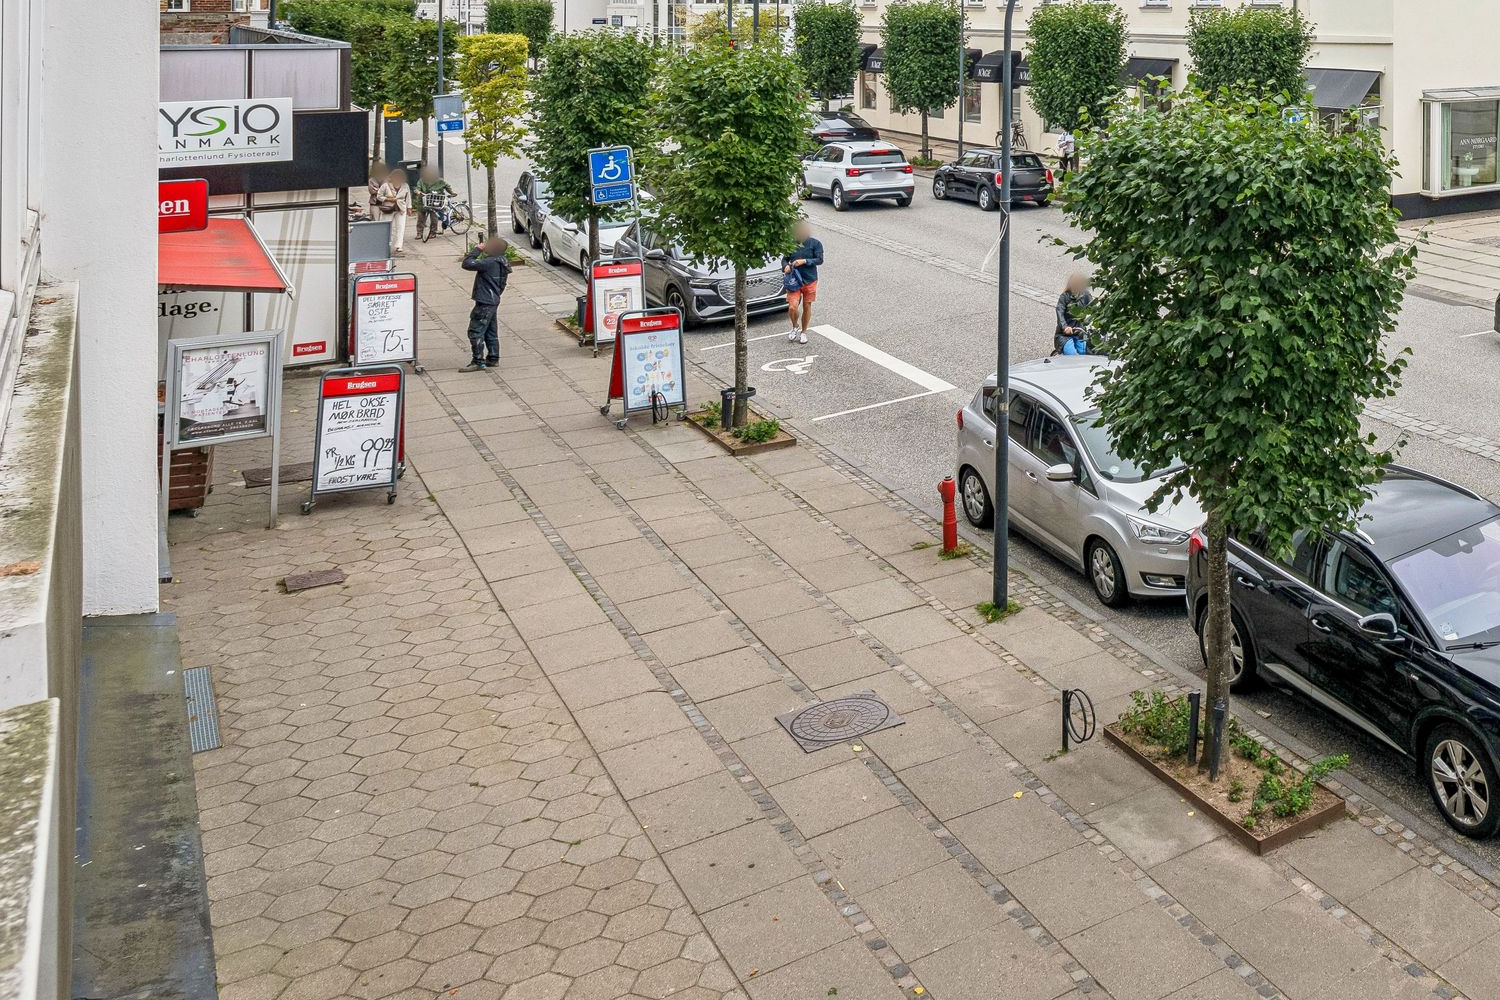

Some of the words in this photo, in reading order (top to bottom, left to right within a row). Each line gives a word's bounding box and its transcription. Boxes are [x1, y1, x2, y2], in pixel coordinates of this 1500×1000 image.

[159, 134, 280, 150] NMARK
[228, 150, 280, 159] Fysioterapi
[158, 199, 190, 213] en
[347, 381, 377, 390] Brugsen
[332, 400, 352, 410] HEL
